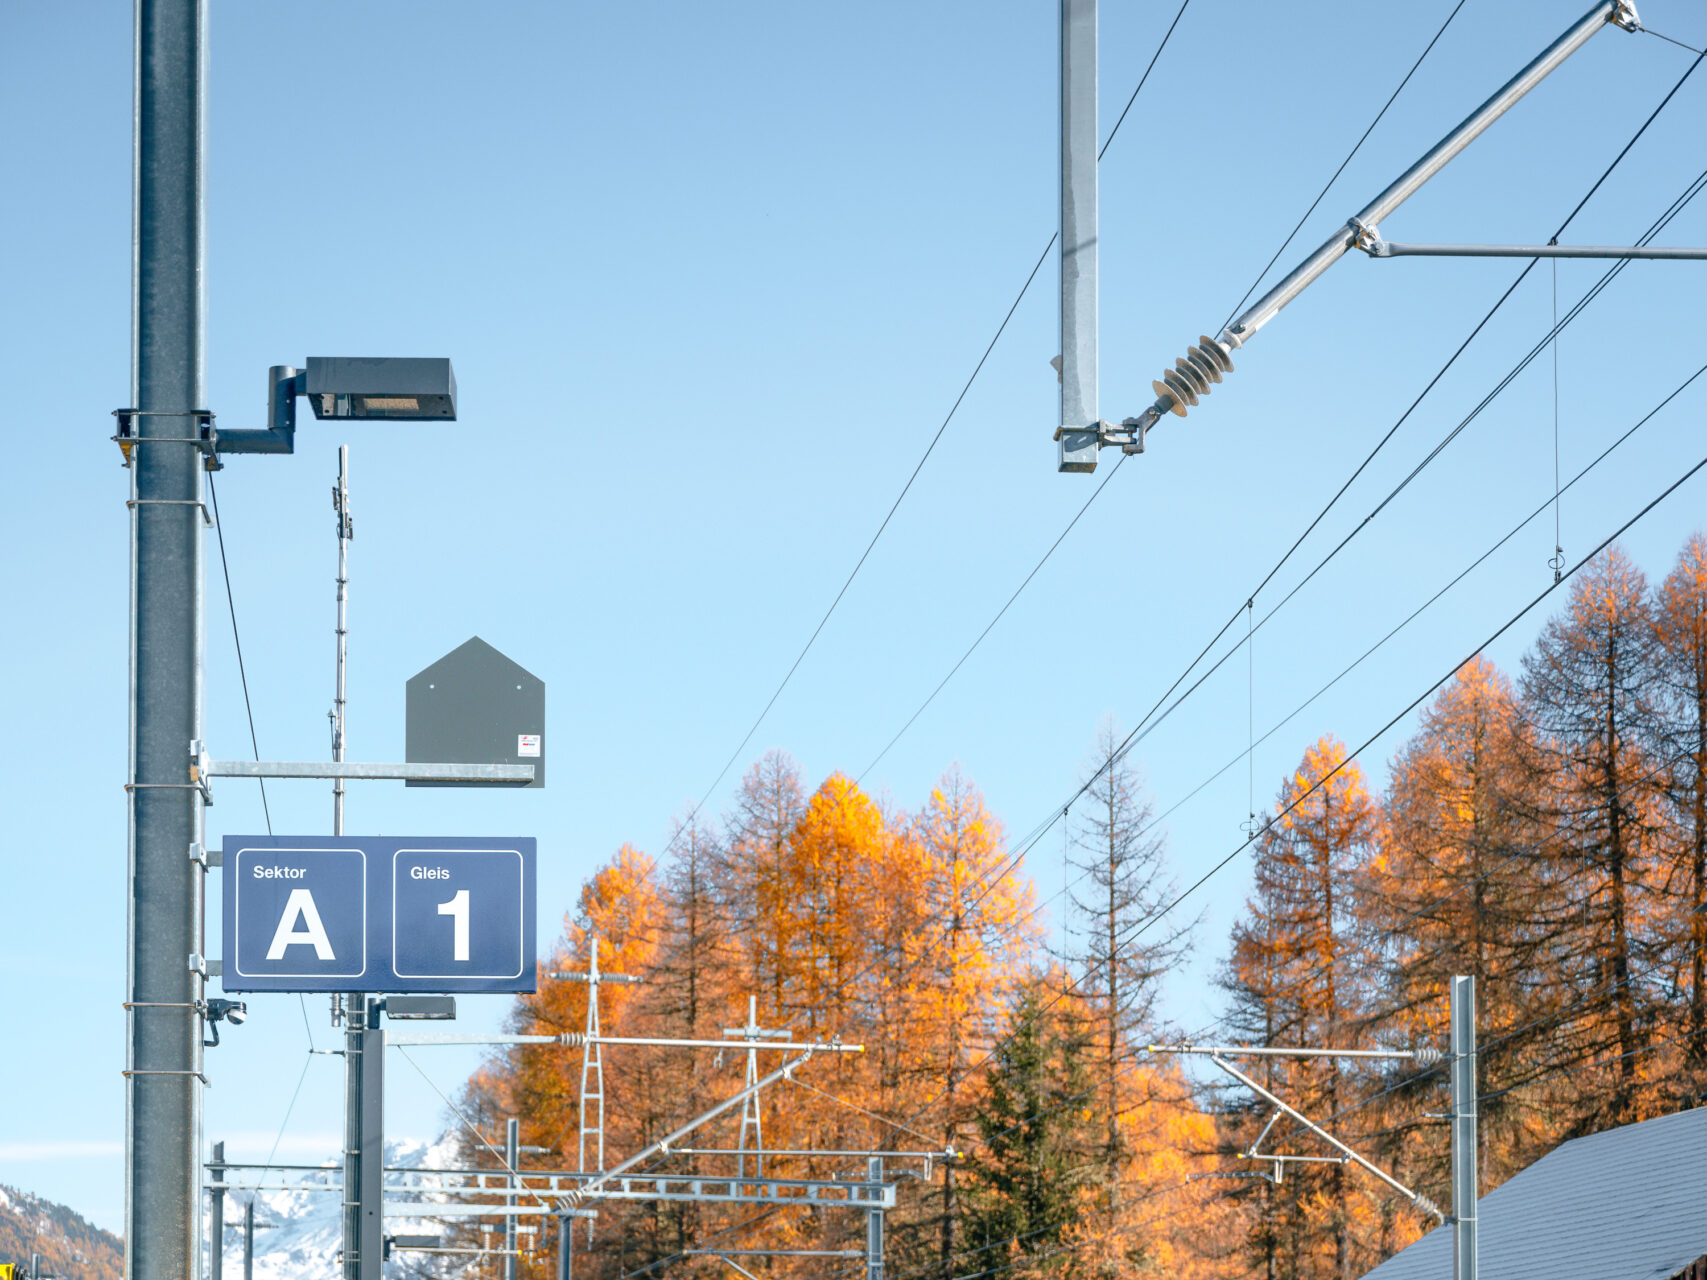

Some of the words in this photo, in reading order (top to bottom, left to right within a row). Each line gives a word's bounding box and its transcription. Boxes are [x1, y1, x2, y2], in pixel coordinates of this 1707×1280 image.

[253, 865, 307, 879] Sektor
[410, 866, 450, 880] Gleis
[266, 888, 336, 960] A
[437, 889, 470, 961] 1
